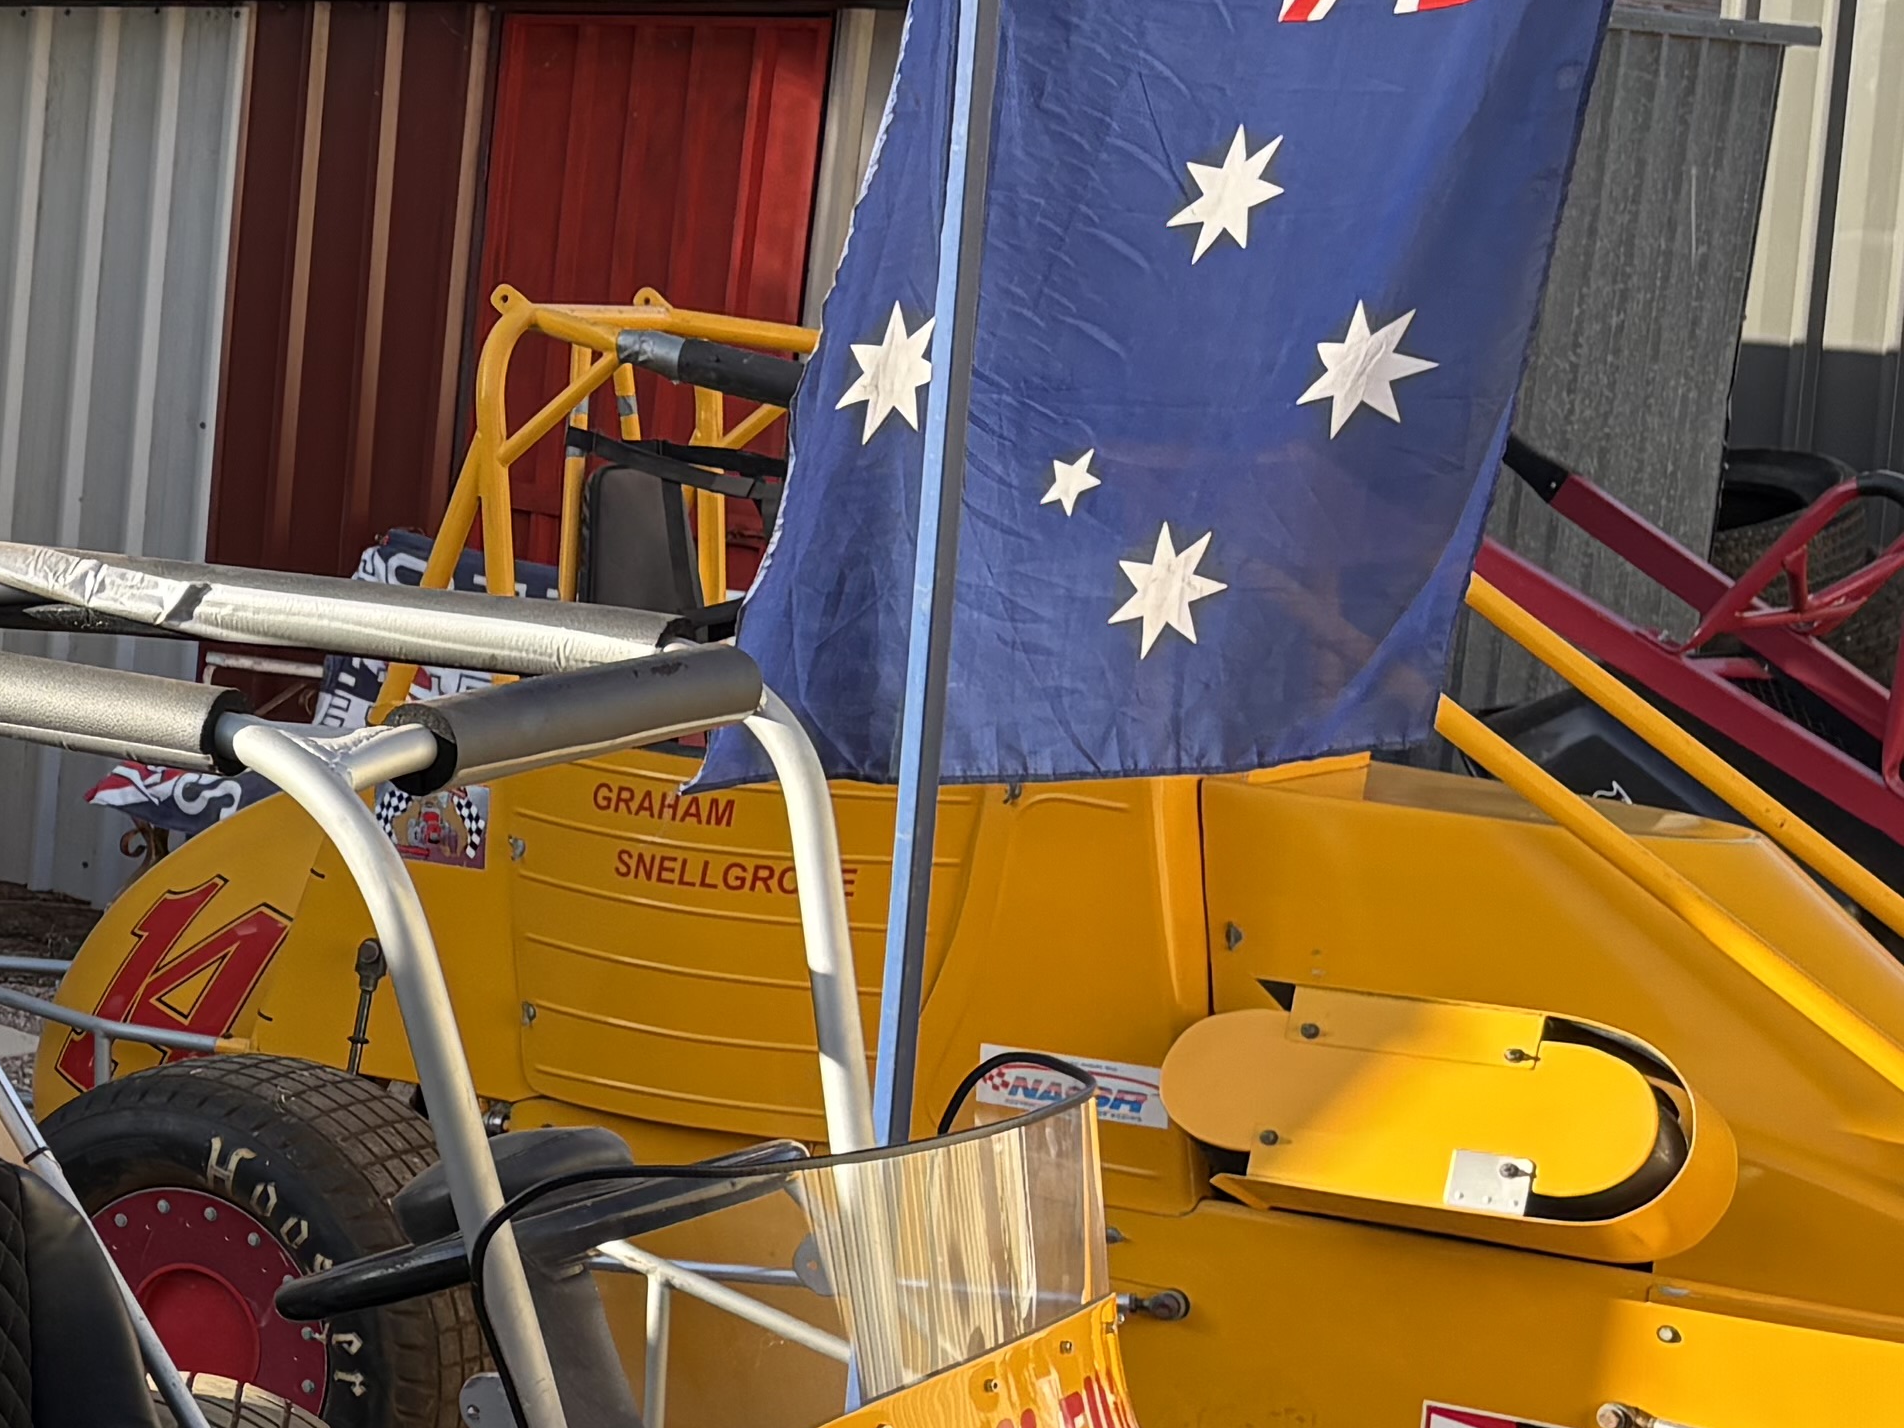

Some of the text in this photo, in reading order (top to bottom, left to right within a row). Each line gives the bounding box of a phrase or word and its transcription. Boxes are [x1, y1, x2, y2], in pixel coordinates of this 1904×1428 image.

[592, 781, 736, 828] GRAHAM
[614, 848, 859, 898] SNELLGROE
[56, 874, 292, 1092] 14
